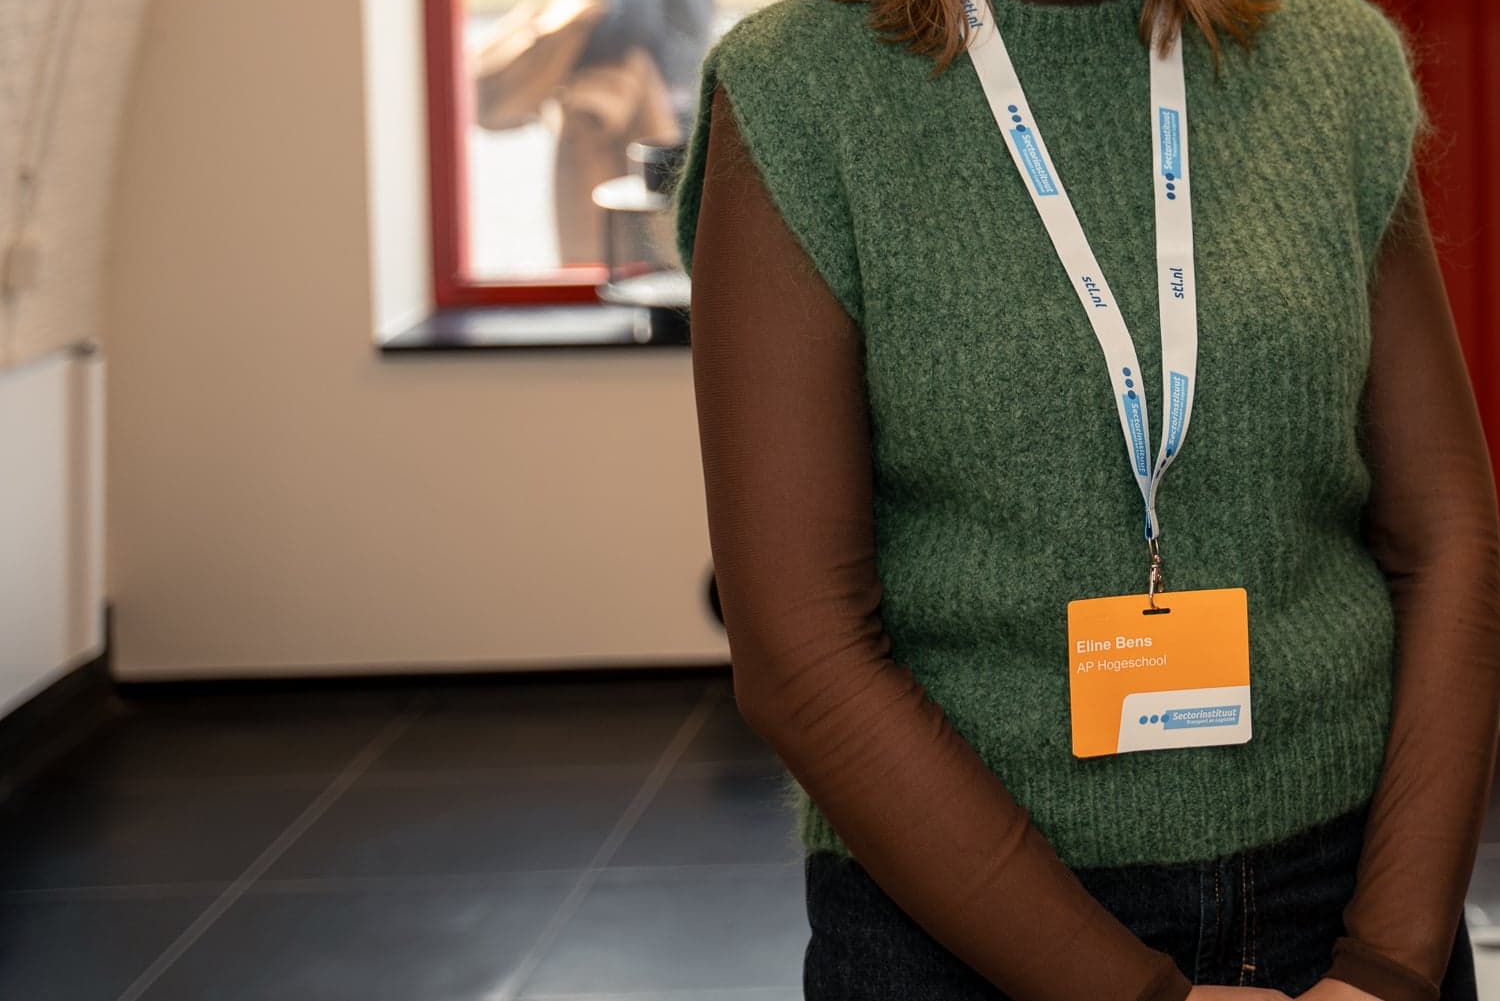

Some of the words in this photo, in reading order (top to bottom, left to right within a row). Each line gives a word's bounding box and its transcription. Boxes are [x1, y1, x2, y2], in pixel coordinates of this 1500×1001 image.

[1081, 276, 1108, 308] stl.nl
[1169, 267, 1185, 300] stl.nl
[1076, 640, 1112, 654] Eline
[1115, 636, 1153, 649] Bens
[1077, 661, 1095, 673] AP
[1097, 655, 1168, 672] Hogeschool
